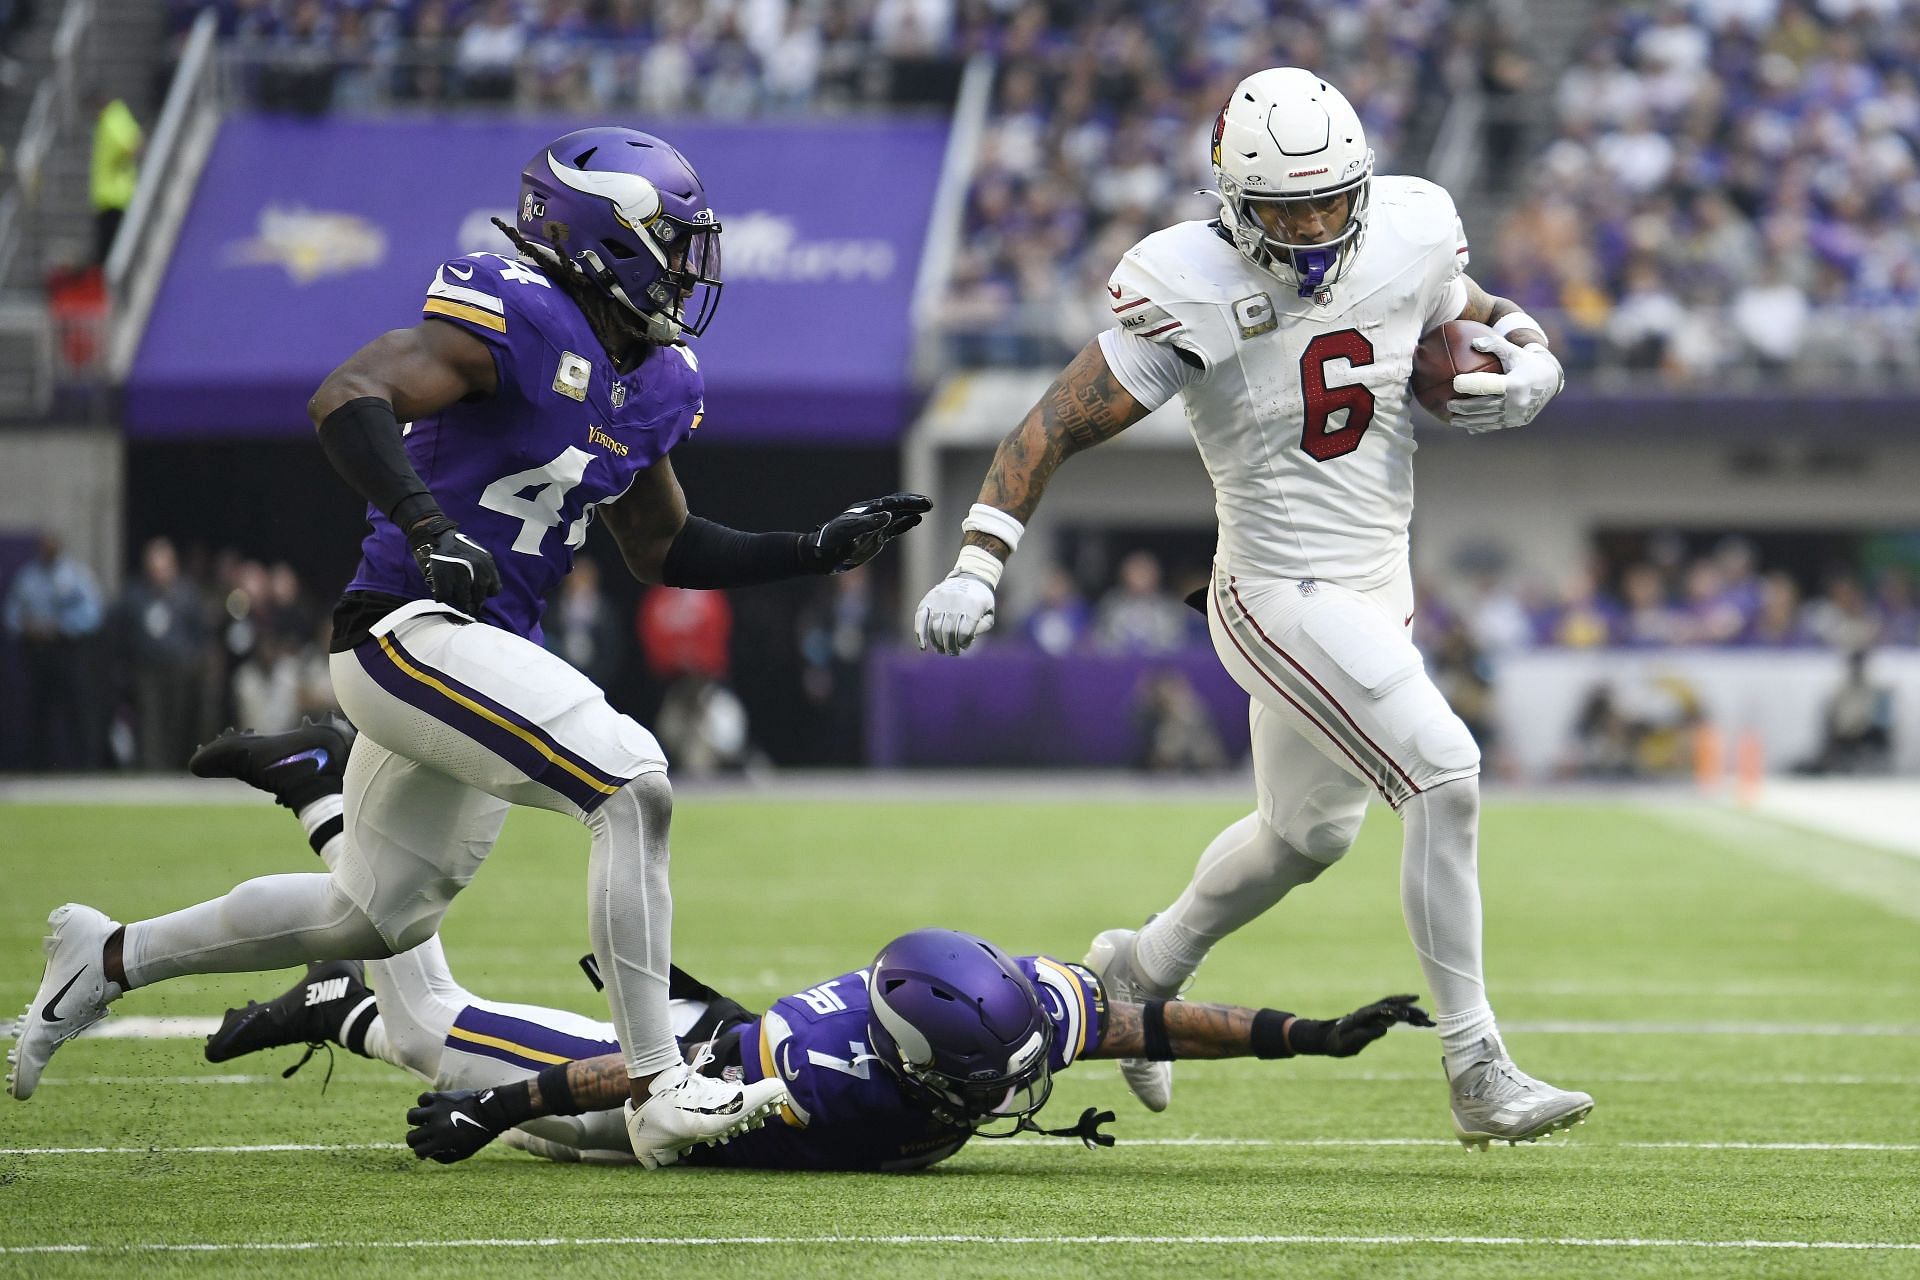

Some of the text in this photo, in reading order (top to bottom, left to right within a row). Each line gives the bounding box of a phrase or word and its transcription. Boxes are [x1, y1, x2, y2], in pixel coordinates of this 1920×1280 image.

[1288, 167, 1329, 179] CARDINALS
[533, 203, 545, 217] KJ
[1237, 295, 1271, 327] C
[560, 355, 589, 389] C
[1300, 328, 1375, 462] 6
[305, 976, 349, 1006] NIKE
